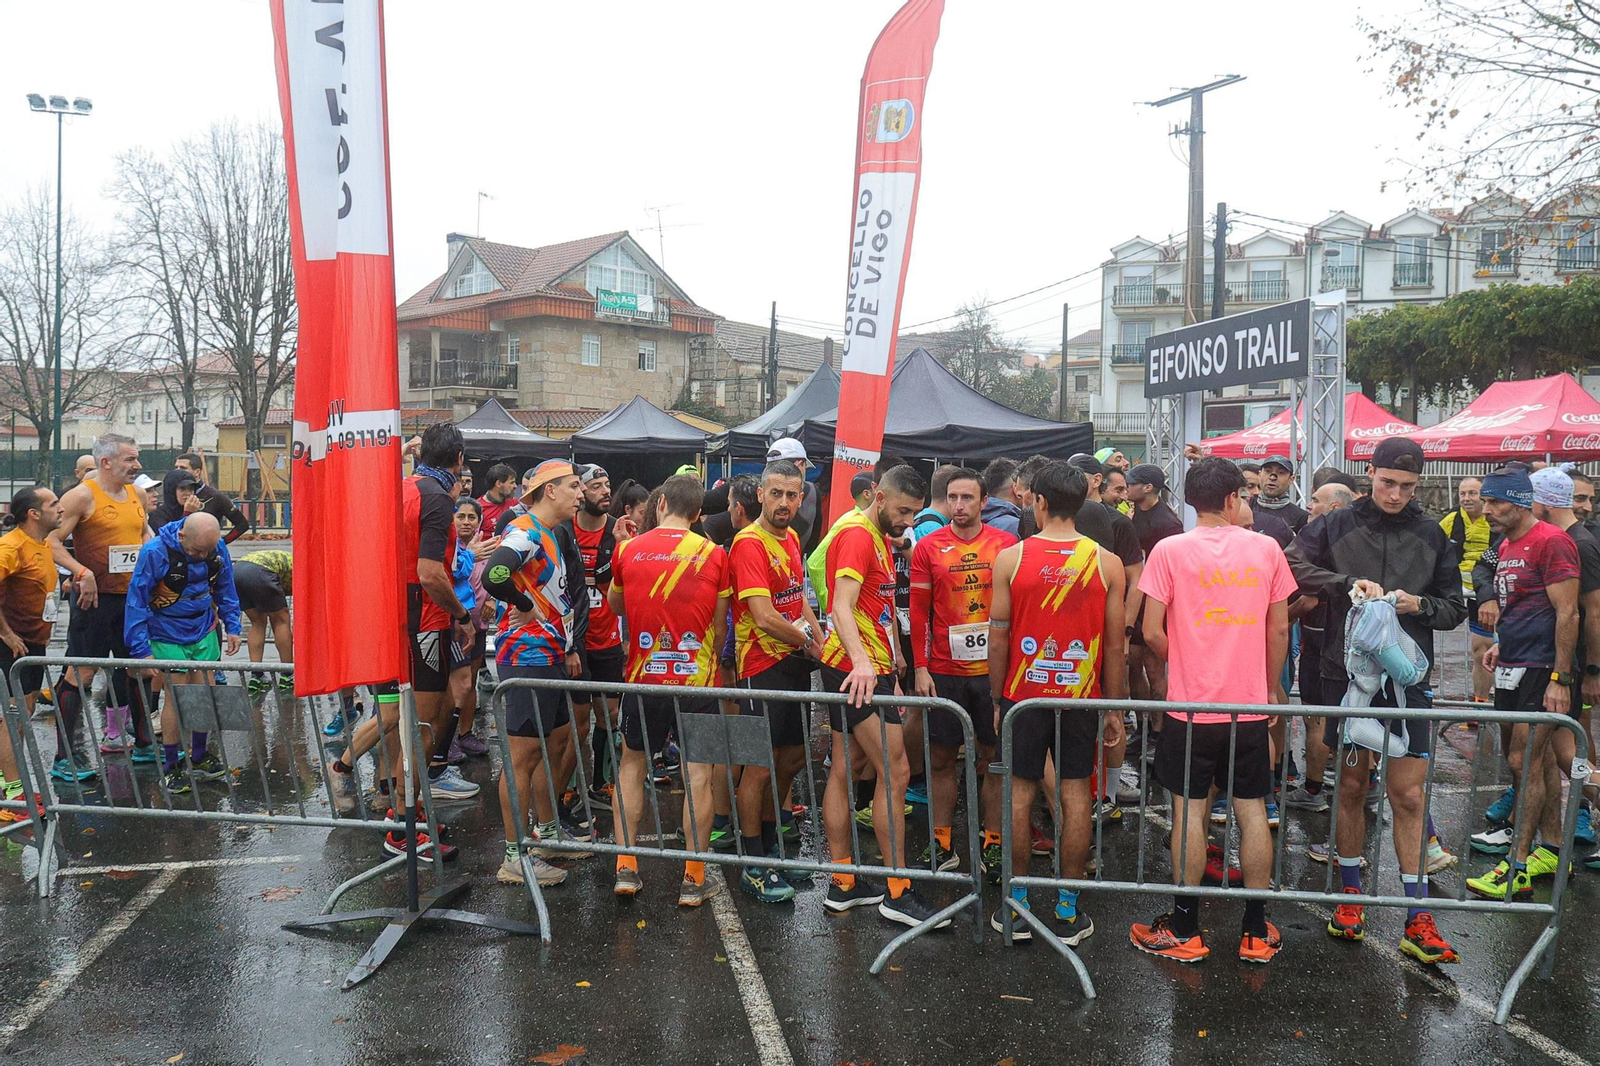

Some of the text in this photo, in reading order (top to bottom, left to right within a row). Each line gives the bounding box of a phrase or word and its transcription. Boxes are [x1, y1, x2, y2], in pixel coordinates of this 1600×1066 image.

[843, 189, 873, 356] CONCELLO
[855, 209, 892, 338] DE VIGO
[1150, 319, 1300, 385] EIFONSO TRAIL
[1500, 435, 1538, 451] Coca-Cola
[121, 552, 137, 563] 76
[965, 633, 986, 648] 86
